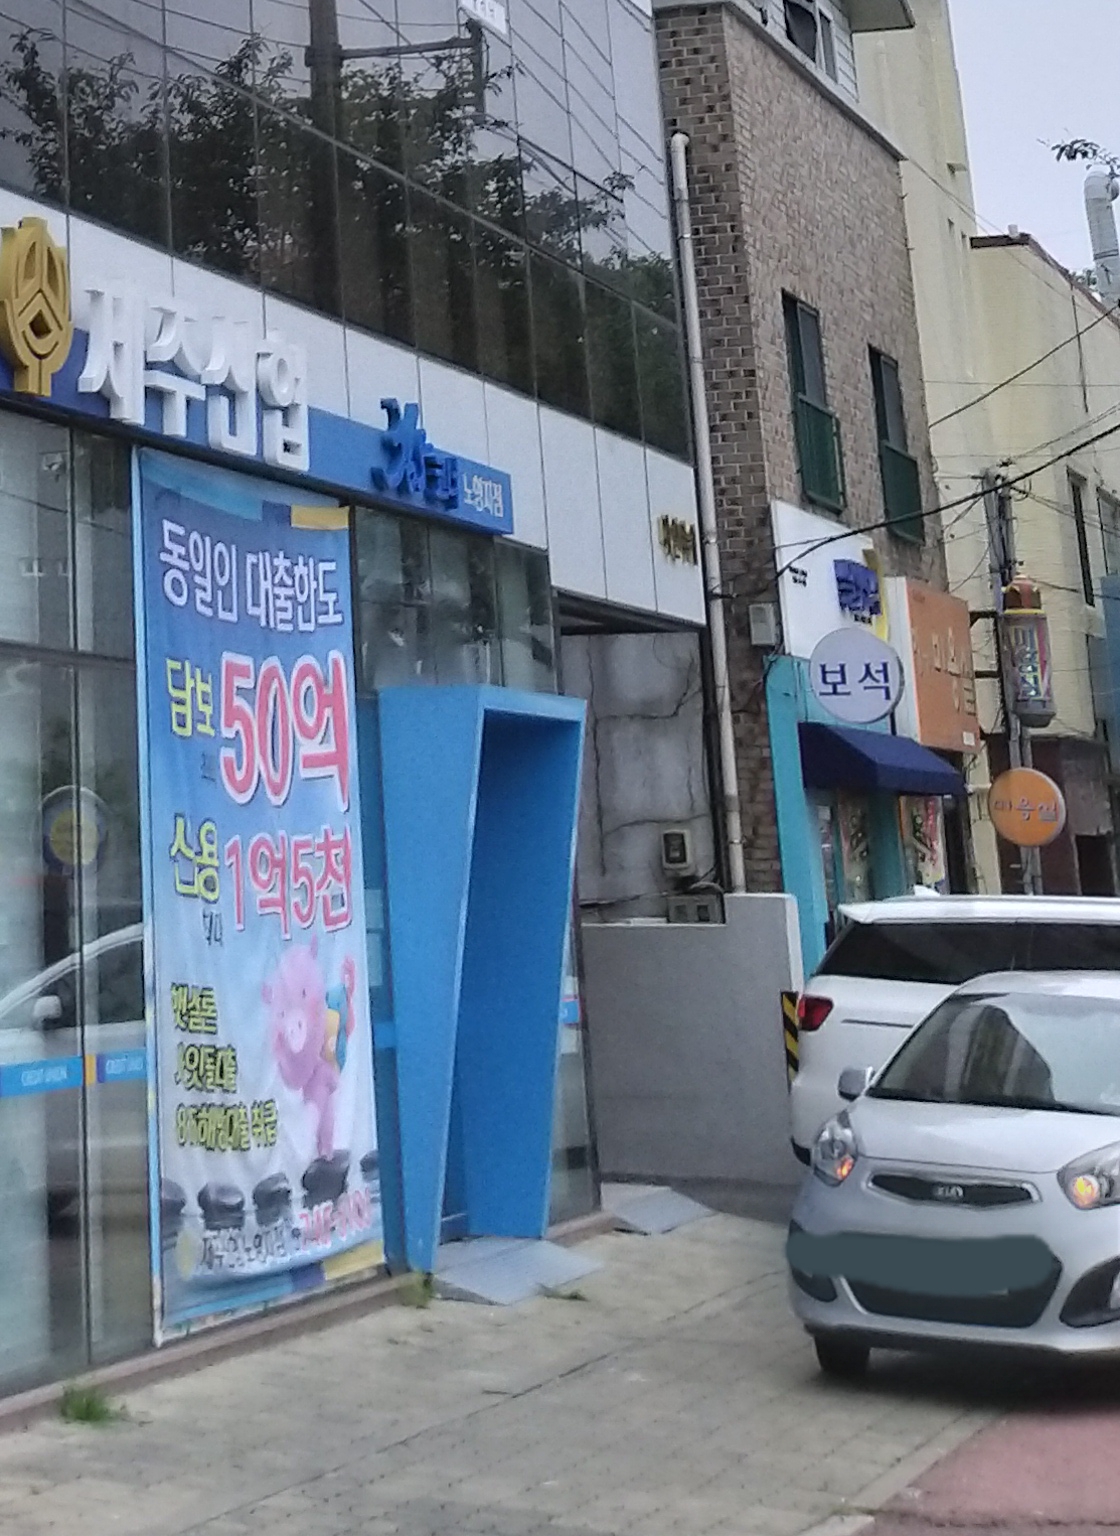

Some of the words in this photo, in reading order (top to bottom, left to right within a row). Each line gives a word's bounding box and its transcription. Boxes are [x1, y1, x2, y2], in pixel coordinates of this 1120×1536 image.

[77, 285, 311, 472] 제주신협
[160, 517, 238, 623] 동일인
[246, 548, 345, 633] 대출한도
[166, 657, 216, 738] 담보
[219, 649, 352, 814] 50억
[818, 660, 892, 701] 보석
[170, 812, 222, 906] 신용
[224, 824, 354, 940] 1억5천
